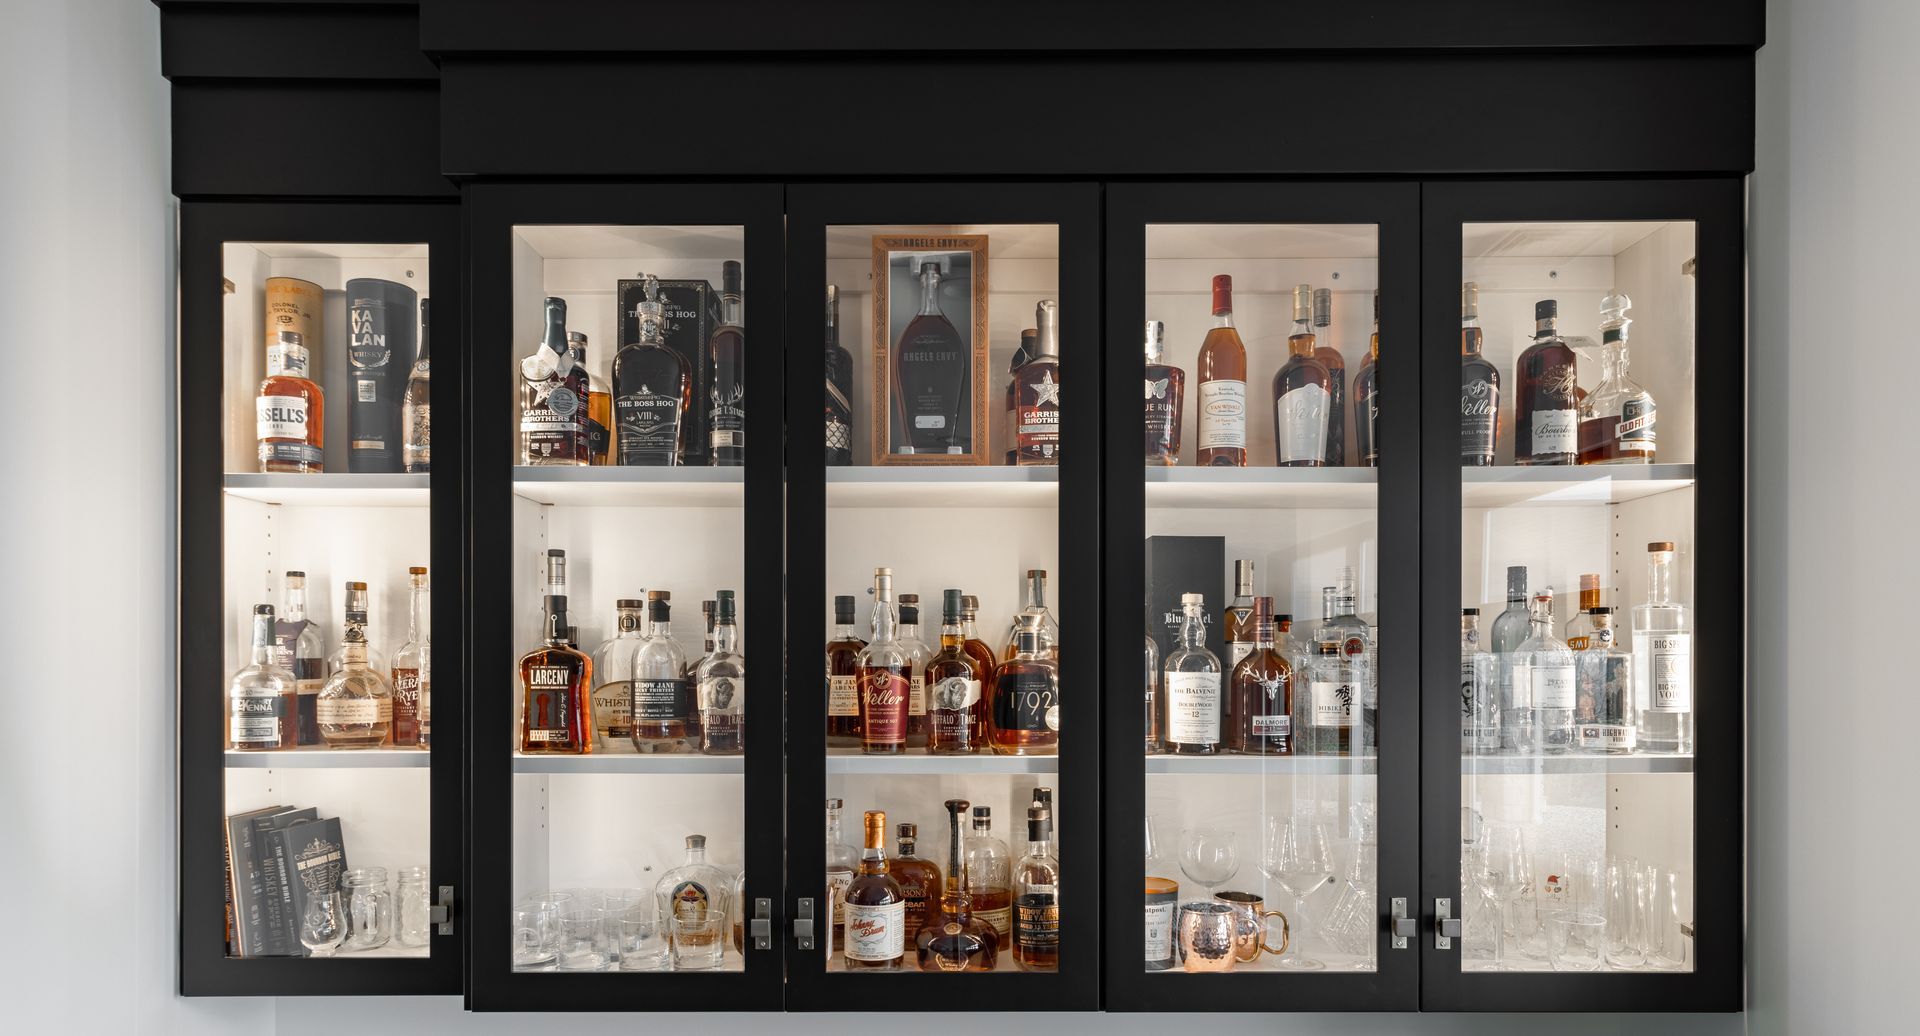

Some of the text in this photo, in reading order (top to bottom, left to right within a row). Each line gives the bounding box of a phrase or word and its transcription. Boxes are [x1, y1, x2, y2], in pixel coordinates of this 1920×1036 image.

[937, 238, 958, 248] ENVY
[352, 310, 372, 322] KA
[352, 322, 372, 334] VA
[352, 334, 386, 346] LAN
[1158, 404, 1174, 412] RUN
[636, 412, 652, 420] VIII
[1620, 421, 1634, 432] OLD
[1654, 640, 1667, 648] BIG
[530, 670, 569, 685] LARCENY
[399, 691, 418, 706] RYE
[1011, 691, 1052, 716] 1792
[960, 714, 976, 724] TRACE
[277, 857, 288, 885] BOURBON
